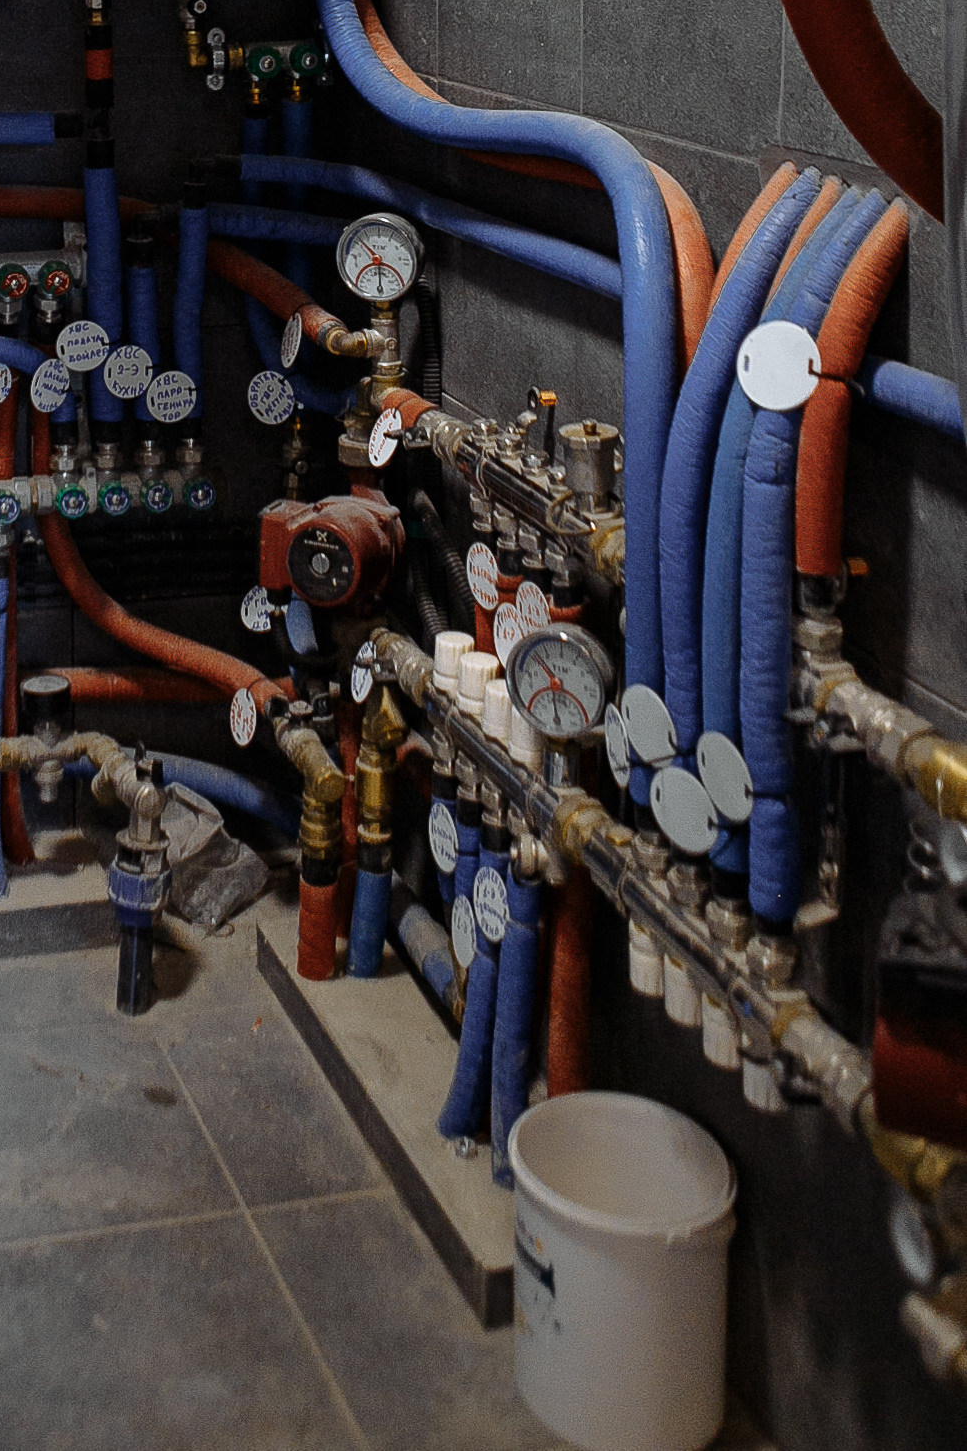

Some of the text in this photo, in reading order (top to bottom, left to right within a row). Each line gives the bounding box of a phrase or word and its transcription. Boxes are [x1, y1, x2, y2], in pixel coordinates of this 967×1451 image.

[67, 322, 90, 335] ХВС
[114, 345, 141, 361] ХВС
[155, 373, 179, 389] ХВС
[260, 384, 275, 405] ГВС
[161, 411, 181, 421] ТОР
